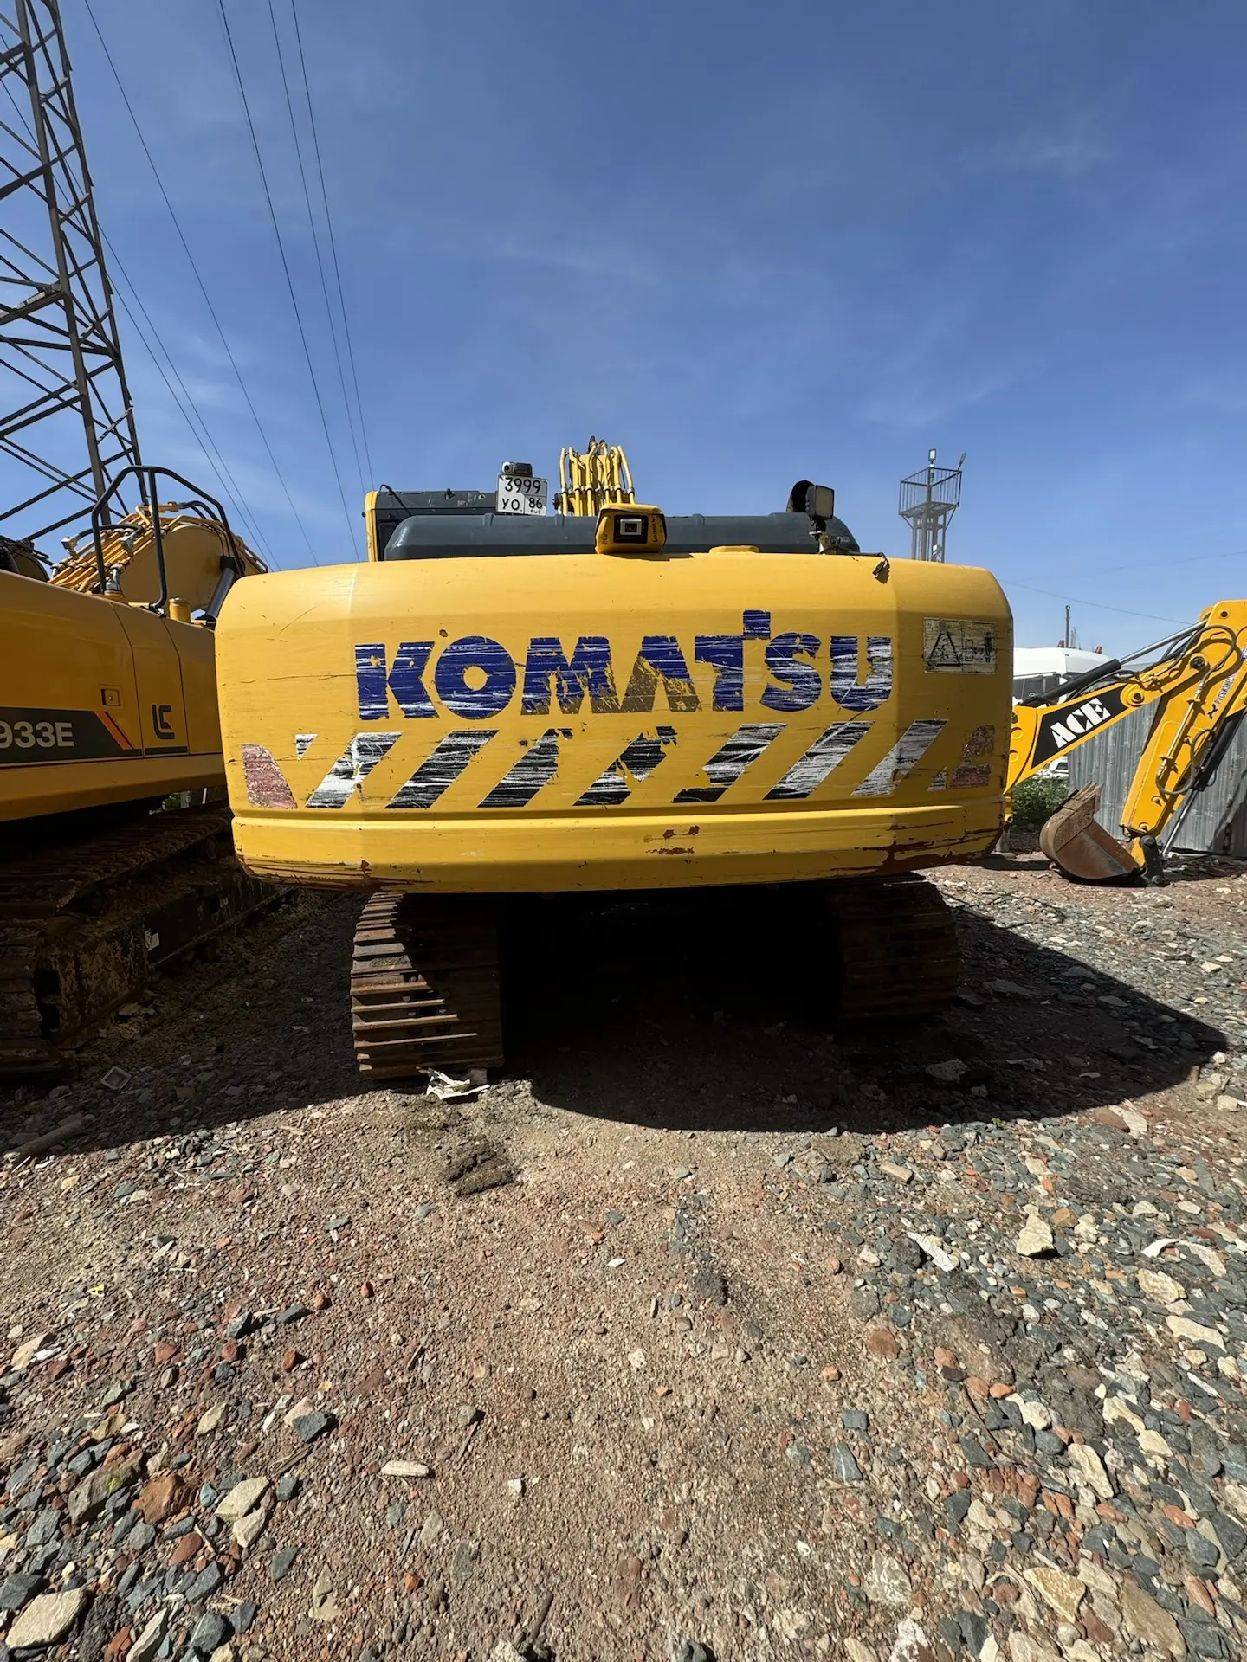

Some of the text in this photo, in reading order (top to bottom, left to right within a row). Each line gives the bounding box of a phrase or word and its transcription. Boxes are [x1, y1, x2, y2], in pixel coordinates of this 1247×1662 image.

[505, 476, 541, 494] 3999
[528, 497, 543, 509] 86
[354, 609, 894, 720] KOMATSU
[1050, 698, 1111, 749] ACE
